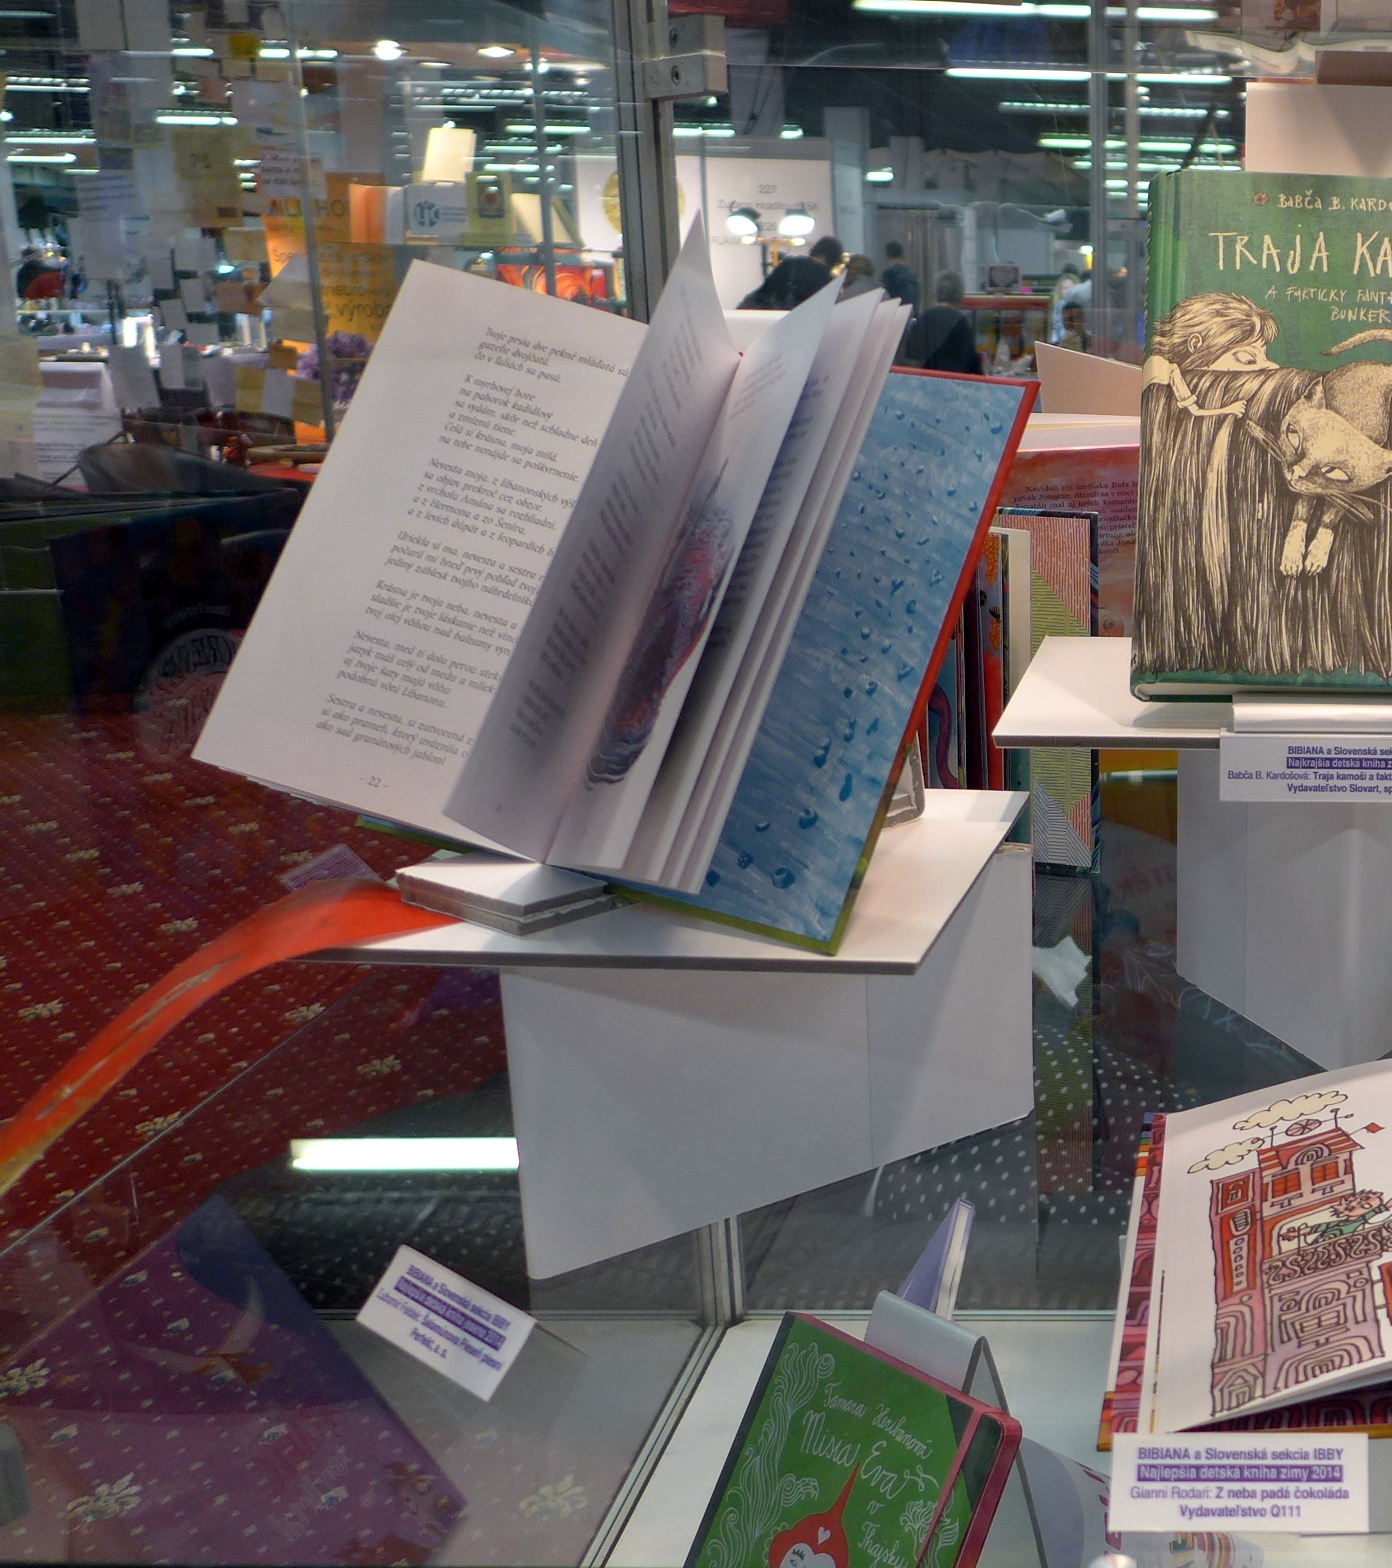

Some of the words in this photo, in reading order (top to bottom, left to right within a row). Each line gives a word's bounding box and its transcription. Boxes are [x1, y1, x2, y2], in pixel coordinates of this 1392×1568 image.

[1208, 225, 1329, 275] TRAJA
[1265, 285, 1279, 301] A
[1329, 306, 1392, 324] BUNKER
[531, 339, 547, 352] dve
[437, 433, 452, 445] na
[452, 436, 474, 451] tebe
[510, 455, 523, 466] sa
[509, 441, 534, 458] moja
[1026, 485, 1059, 493] Nevideli
[1076, 483, 1109, 491] myšiaka
[1013, 495, 1036, 503] prvák
[1068, 501, 1076, 509] aj
[1078, 500, 1100, 509] iných
[428, 497, 472, 519] Hermona
[480, 514, 493, 525] zo
[494, 505, 507, 516] sa
[461, 550, 496, 568] nevesta
[507, 563, 536, 579] sestra
[462, 563, 484, 580] prvý
[484, 569, 518, 589] pohľad
[1287, 746, 1325, 755] BIBIANA
[1334, 746, 1378, 756] Slovenská
[1288, 757, 1330, 769] Najkrajšia
[1332, 758, 1360, 768] detská
[1362, 759, 1386, 768] kniha
[366, 774, 382, 789] 22
[1227, 770, 1253, 780] Babča
[1255, 770, 1264, 780] B.
[1266, 770, 1311, 780] Kardošová:
[1312, 771, 1334, 782] Traja
[1336, 772, 1367, 781] kamoši
[1368, 773, 1374, 781] a
[1287, 783, 1347, 794] Vydavateľstvo
[1349, 784, 1382, 794] Slovart,
[823, 1380, 868, 1418] Tamara
[1137, 1447, 1191, 1460] BIBIANA
[1194, 1450, 1201, 1460] a
[1204, 1446, 1268, 1461] Slovenská
[1271, 1447, 1310, 1460] sekcia
[1313, 1447, 1344, 1461] IBBY
[860, 1440, 911, 1500] Eva
[1139, 1464, 1197, 1481] Najlepšia
[1199, 1464, 1241, 1479] detská
[1243, 1464, 1278, 1479] kniha
[1279, 1465, 1310, 1481] zimy
[1311, 1465, 1341, 1480] 2014
[1130, 1486, 1168, 1499] Gianni
[1171, 1486, 1213, 1500] Rodari:
[1215, 1487, 1224, 1499] Z
[1227, 1486, 1257, 1500] neba
[1260, 1485, 1291, 1502] padá
[1294, 1485, 1350, 1500] čokoláda
[867, 1499, 885, 1516] v
[1179, 1504, 1268, 1521] Vydavateľstvo
[1270, 1505, 1301, 1518] Q111
